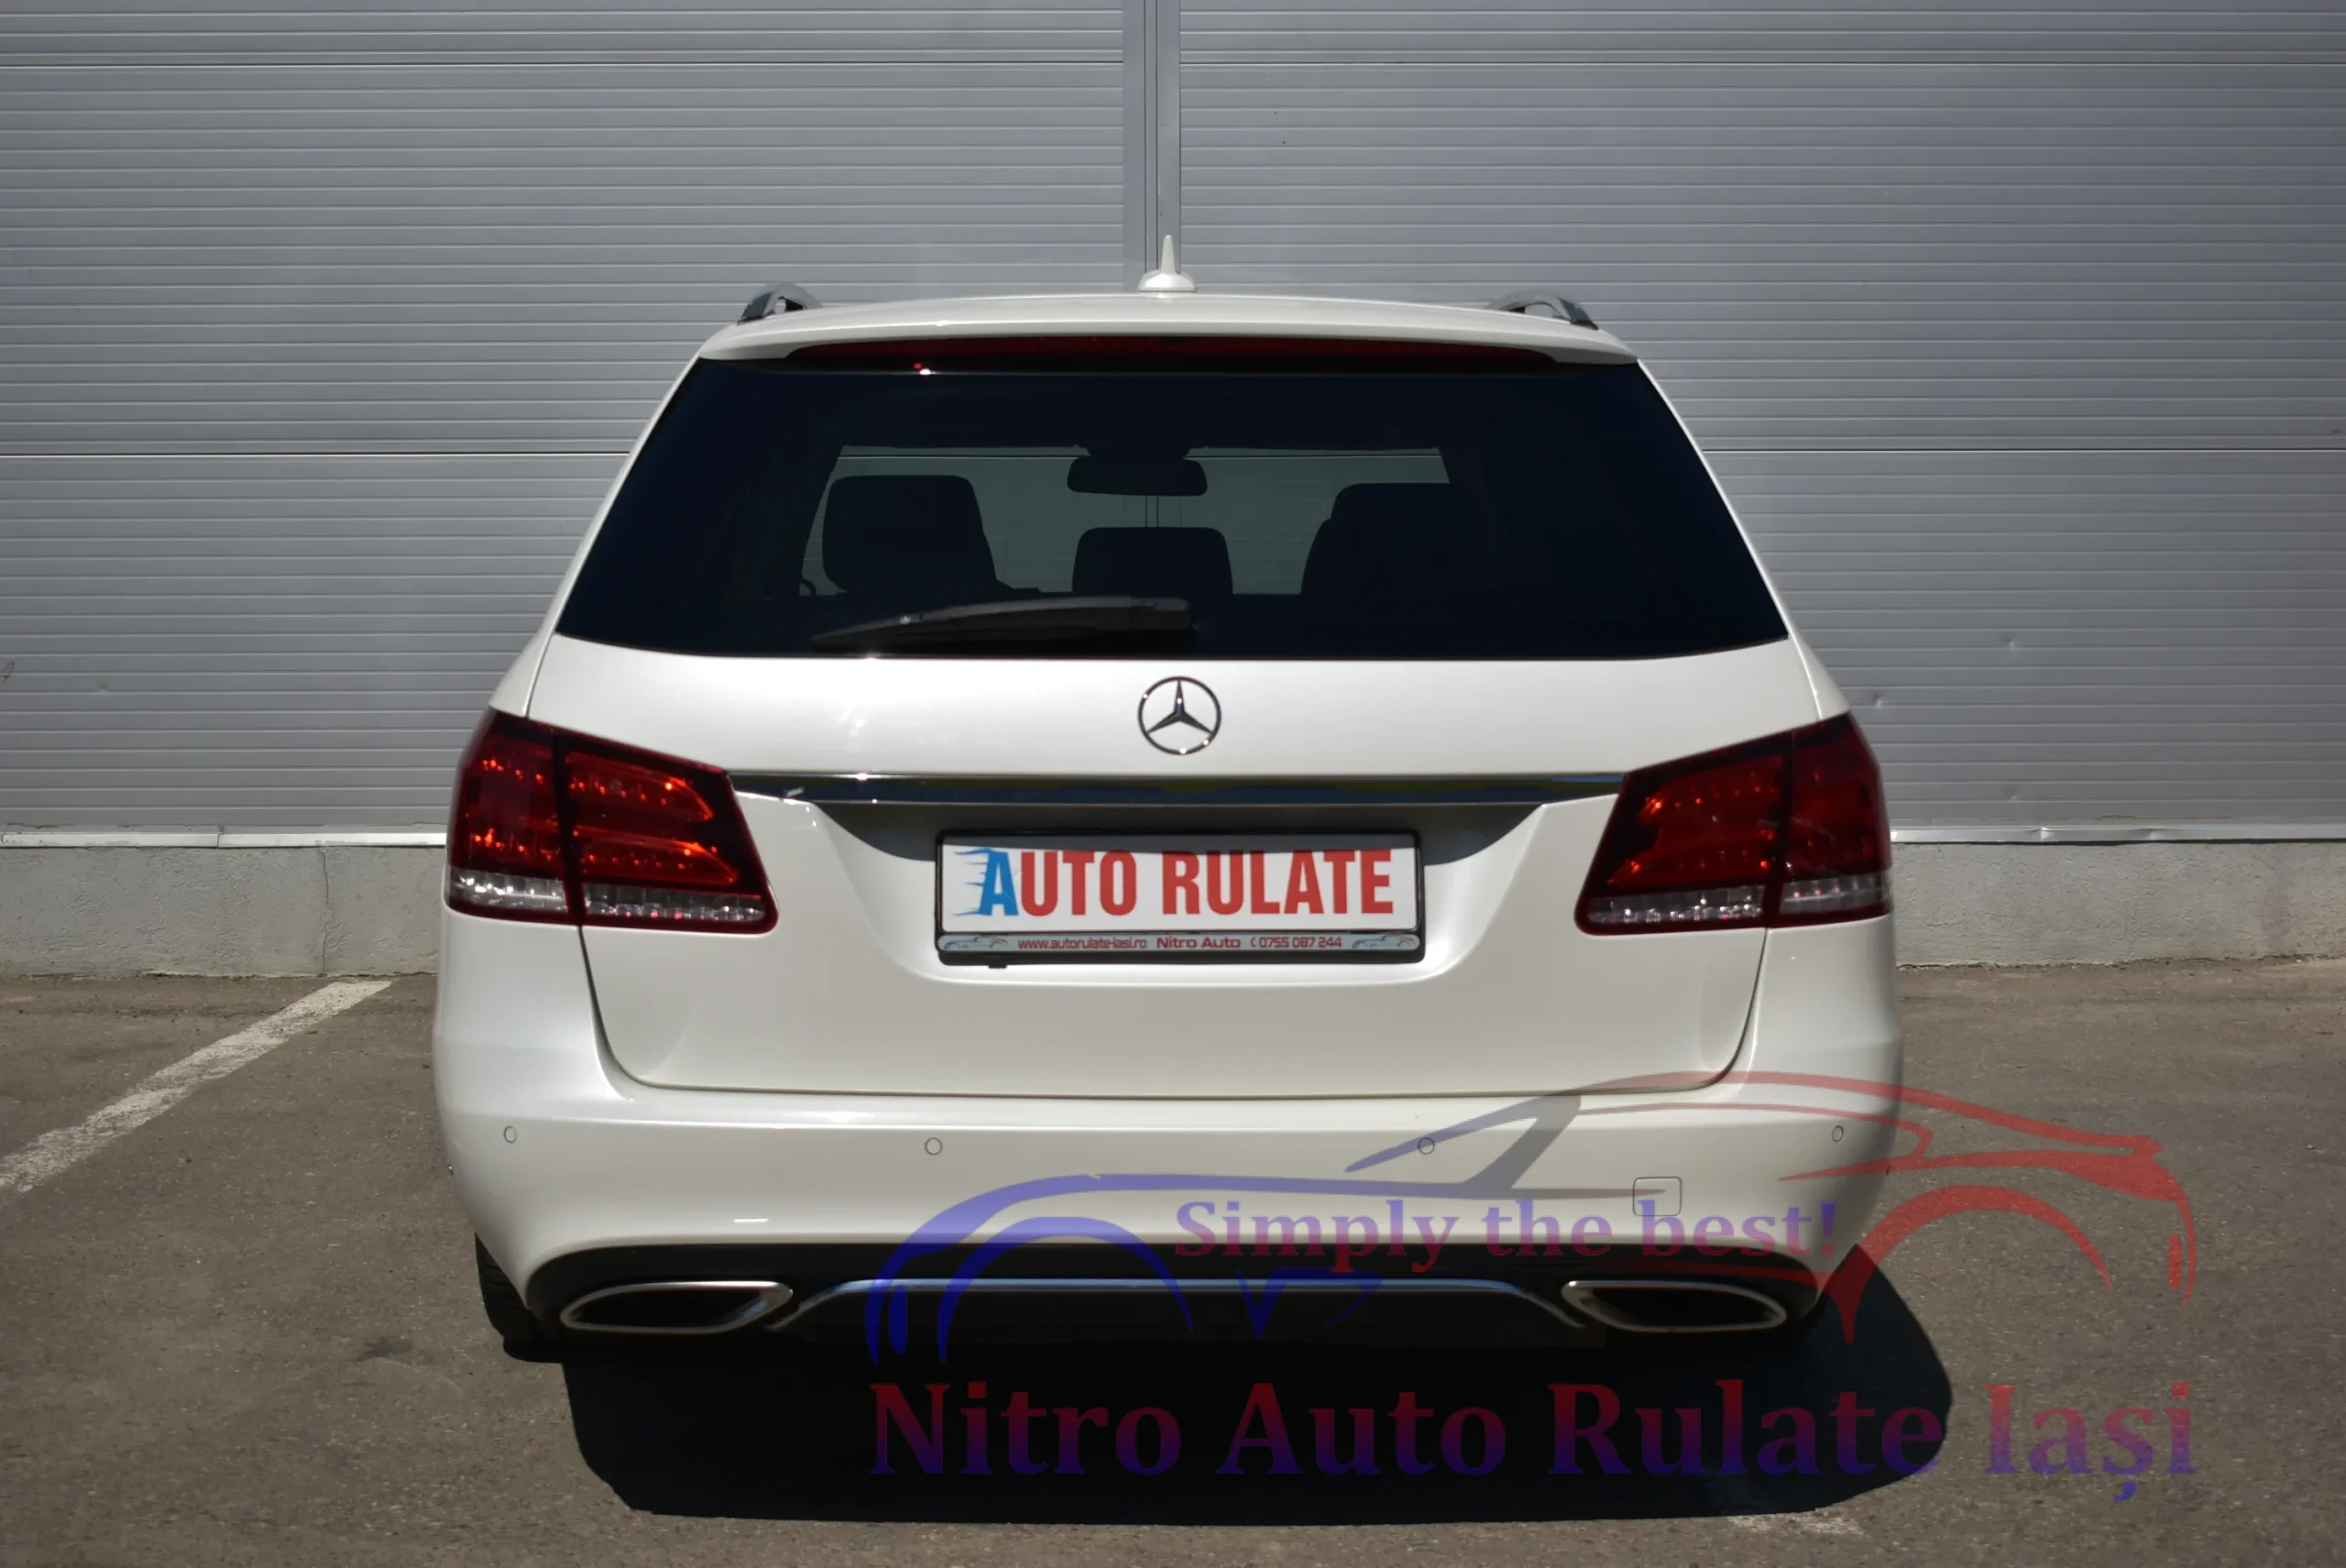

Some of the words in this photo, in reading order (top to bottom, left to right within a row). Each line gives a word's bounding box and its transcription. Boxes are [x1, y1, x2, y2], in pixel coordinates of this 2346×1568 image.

[957, 849, 1136, 916] AUTO
[1163, 850, 1393, 915] RULATE
[1018, 937, 1147, 949] www.autorulate-iasi.ro
[1156, 936, 1198, 948] Nitro
[1201, 937, 1241, 948] Auto
[1291, 937, 1316, 948] 087
[1318, 937, 1343, 948] 244
